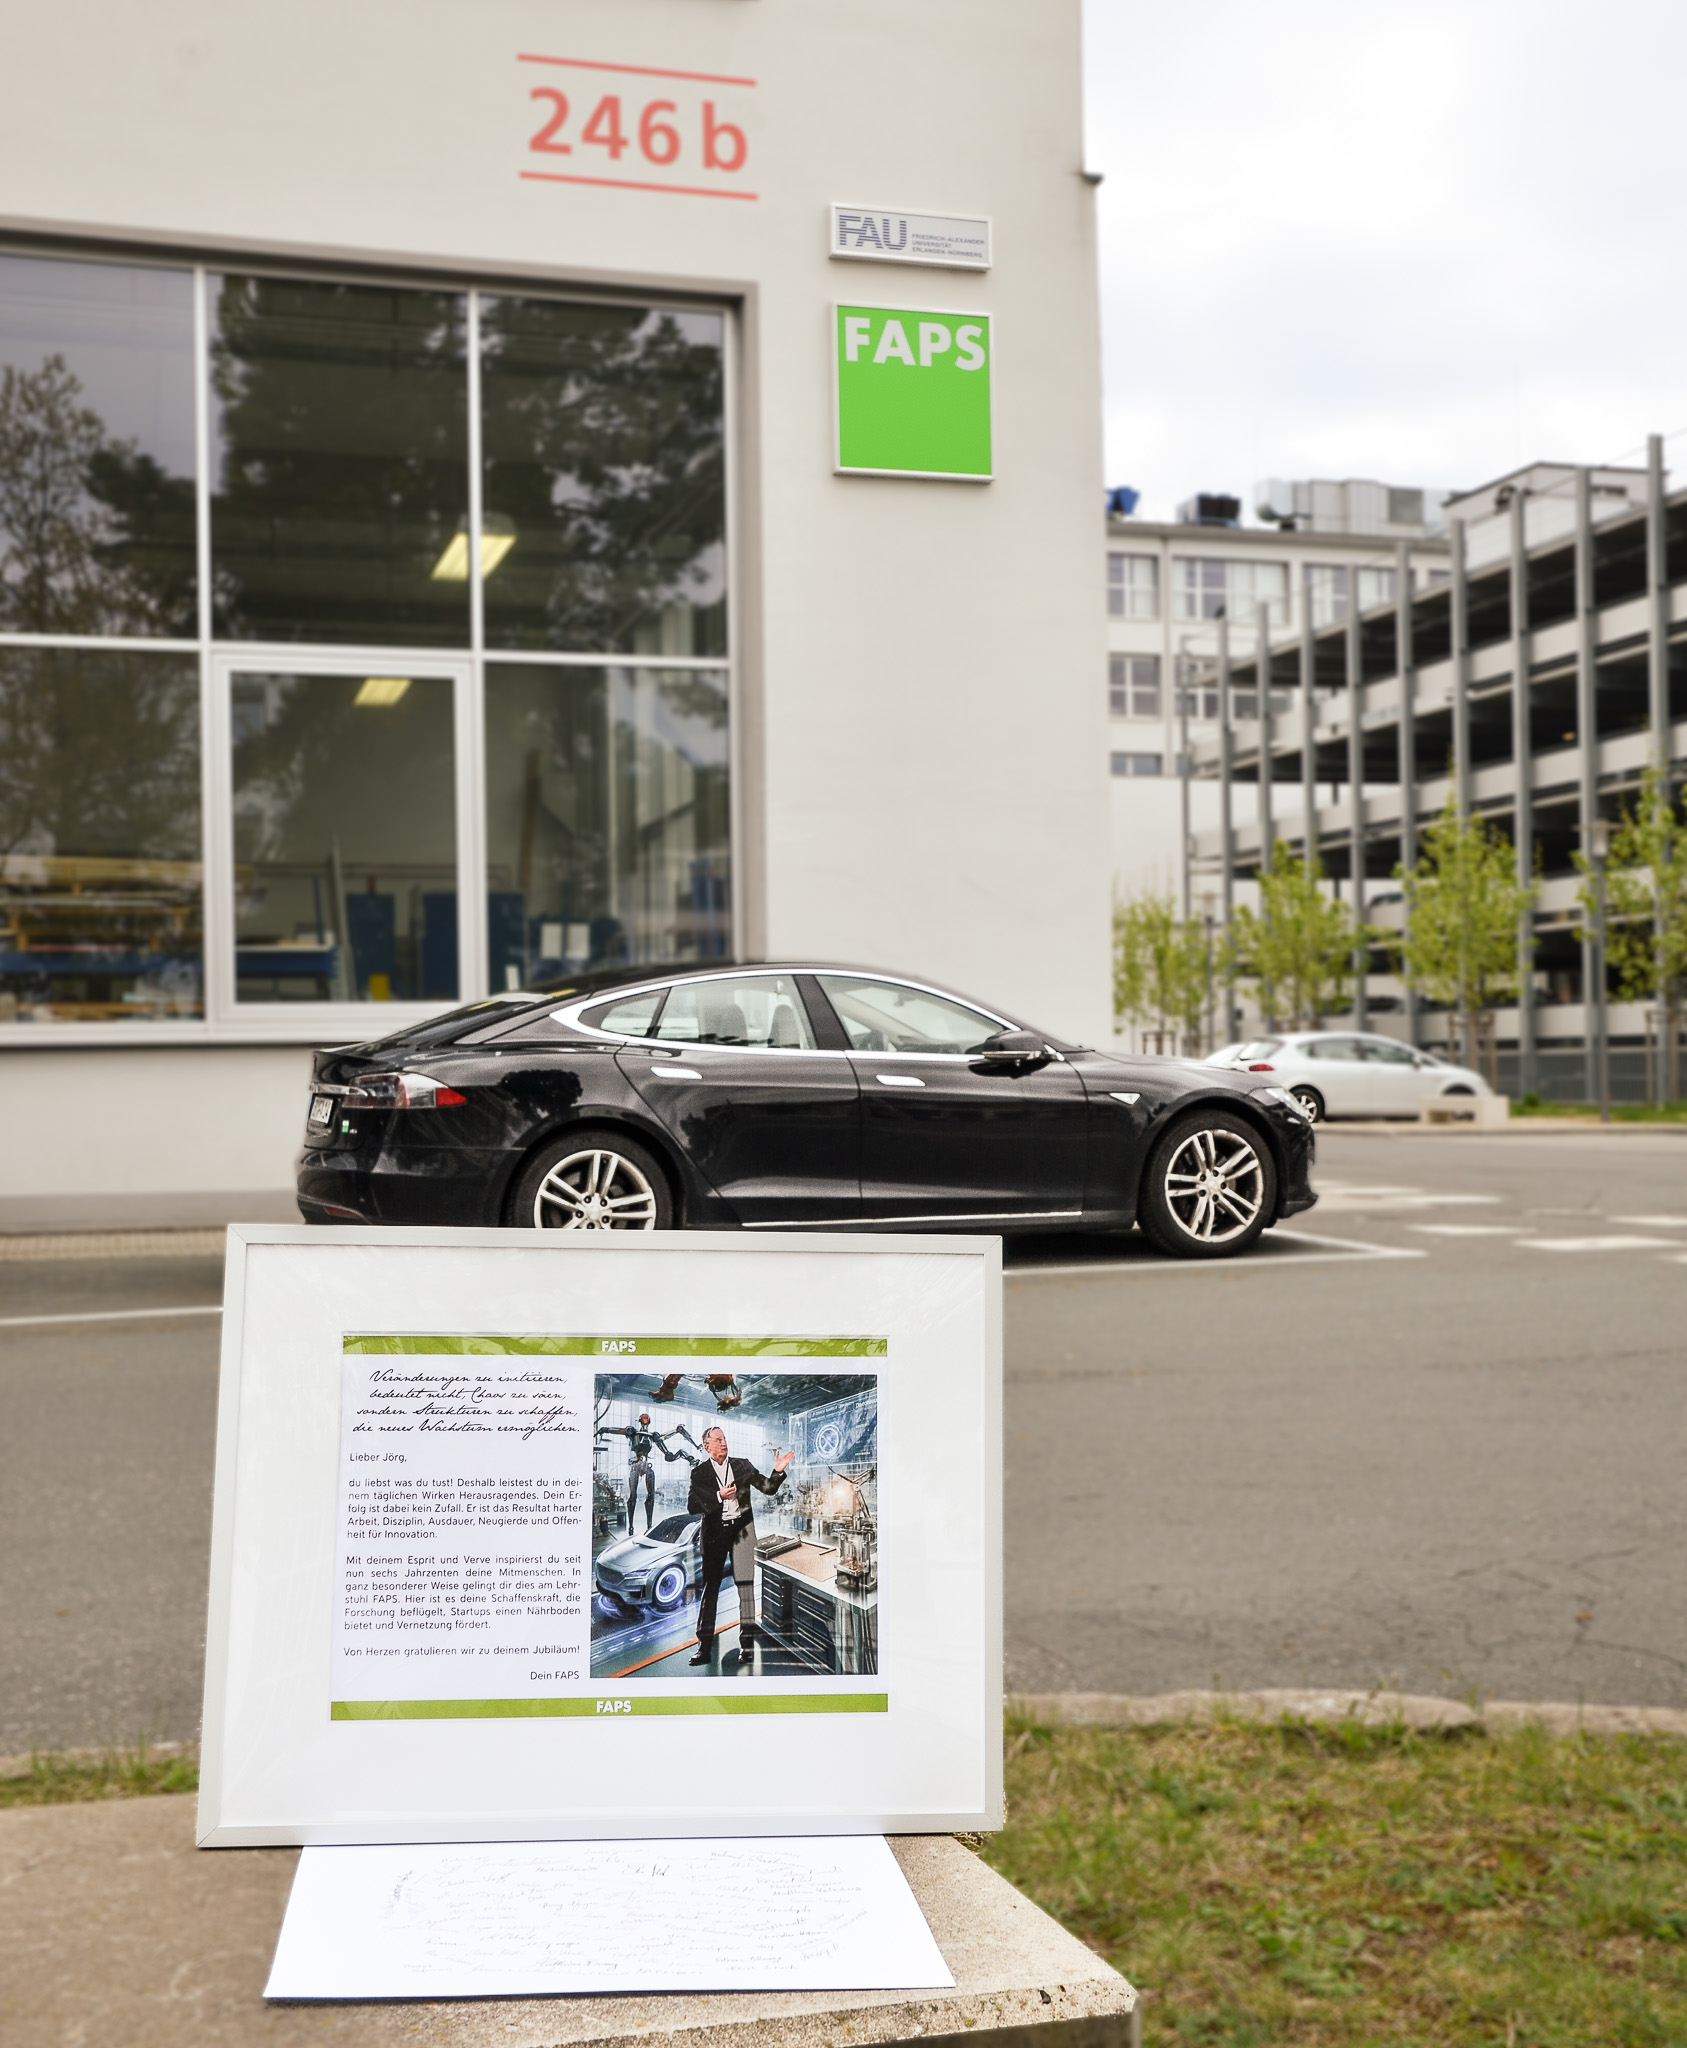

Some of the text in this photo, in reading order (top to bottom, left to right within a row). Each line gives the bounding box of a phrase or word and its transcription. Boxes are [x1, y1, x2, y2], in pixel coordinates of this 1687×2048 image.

[527, 86, 748, 173] 246 b
[839, 214, 907, 251] FAU
[911, 233, 985, 245] FRIEDRICH-ALEXANDER
[911, 240, 952, 249] UNIVERSITÄT
[844, 315, 986, 372] FAPS
[601, 1340, 637, 1354] FAPS
[369, 1388, 426, 1399] bedeutet
[426, 1388, 469, 1400] nicht,
[471, 1386, 506, 1404] Chaos
[532, 1391, 567, 1400] säen,
[356, 1404, 408, 1415] sondern
[412, 1402, 493, 1416] Strukturen
[518, 1406, 579, 1424] schaffen,
[352, 1422, 373, 1432] die
[418, 1418, 494, 1432] Wachstum
[496, 1421, 580, 1441] ermöglichen.
[350, 1453, 407, 1463] Lieber Jörg,
[349, 1478, 361, 1487] du
[365, 1478, 390, 1487] liebst
[416, 1478, 428, 1487] du
[432, 1479, 453, 1487] tust!
[457, 1478, 495, 1487] Deshalb
[500, 1478, 532, 1487] leistest
[537, 1478, 548, 1486] du
[553, 1478, 560, 1486] in
[565, 1478, 582, 1486] dei-
[374, 1491, 417, 1502] täglichen
[422, 1491, 455, 1499] Wirken
[460, 1491, 539, 1501] Herausragendes.
[544, 1491, 564, 1499] Dein
[569, 1491, 582, 1499] Er-
[348, 1503, 582, 1515] folg ist dabei kein Zufall. Er ist das Resultat harter
[348, 1516, 581, 1527] Arbeit, Disziplin, Ausdauer, Neugierde und Offen-
[348, 1530, 437, 1538] heit für Innovation.
[347, 1555, 581, 1566] Mit deinem Esprit und Verve inspirierst du seit
[371, 1569, 397, 1577] sechs
[405, 1568, 458, 1577] Jahrzenten
[466, 1568, 492, 1577] deine
[499, 1568, 565, 1576] Mitmenschen.
[573, 1568, 581, 1576] In
[346, 1584, 368, 1593] ganz
[372, 1582, 427, 1590] besonderer
[431, 1581, 459, 1590] Weise
[463, 1581, 495, 1592] gelingt
[499, 1581, 512, 1589] dir
[516, 1581, 534, 1589] dies
[557, 1580, 580, 1589] Lehr-
[345, 1595, 368, 1603] stuhl
[373, 1595, 400, 1603] FAPS.
[405, 1595, 425, 1603] Hier
[430, 1595, 440, 1603] ist
[460, 1594, 486, 1603] deine
[492, 1593, 561, 1603] Schaffenskraft,
[566, 1593, 580, 1602] die
[345, 1606, 580, 1618] Forschung beflügelt, Startups einen Nährboden
[345, 1620, 490, 1631] bietet und Vernetzung fördert.
[344, 1648, 362, 1656] Von
[366, 1648, 400, 1656] Herzen
[404, 1647, 456, 1657] gratulieren
[461, 1646, 475, 1654] wir
[494, 1646, 529, 1654] deinem
[533, 1645, 579, 1654] Jubiläum!
[531, 1671, 579, 1680] Dein FAPS
[595, 1700, 632, 1714] FAPS
